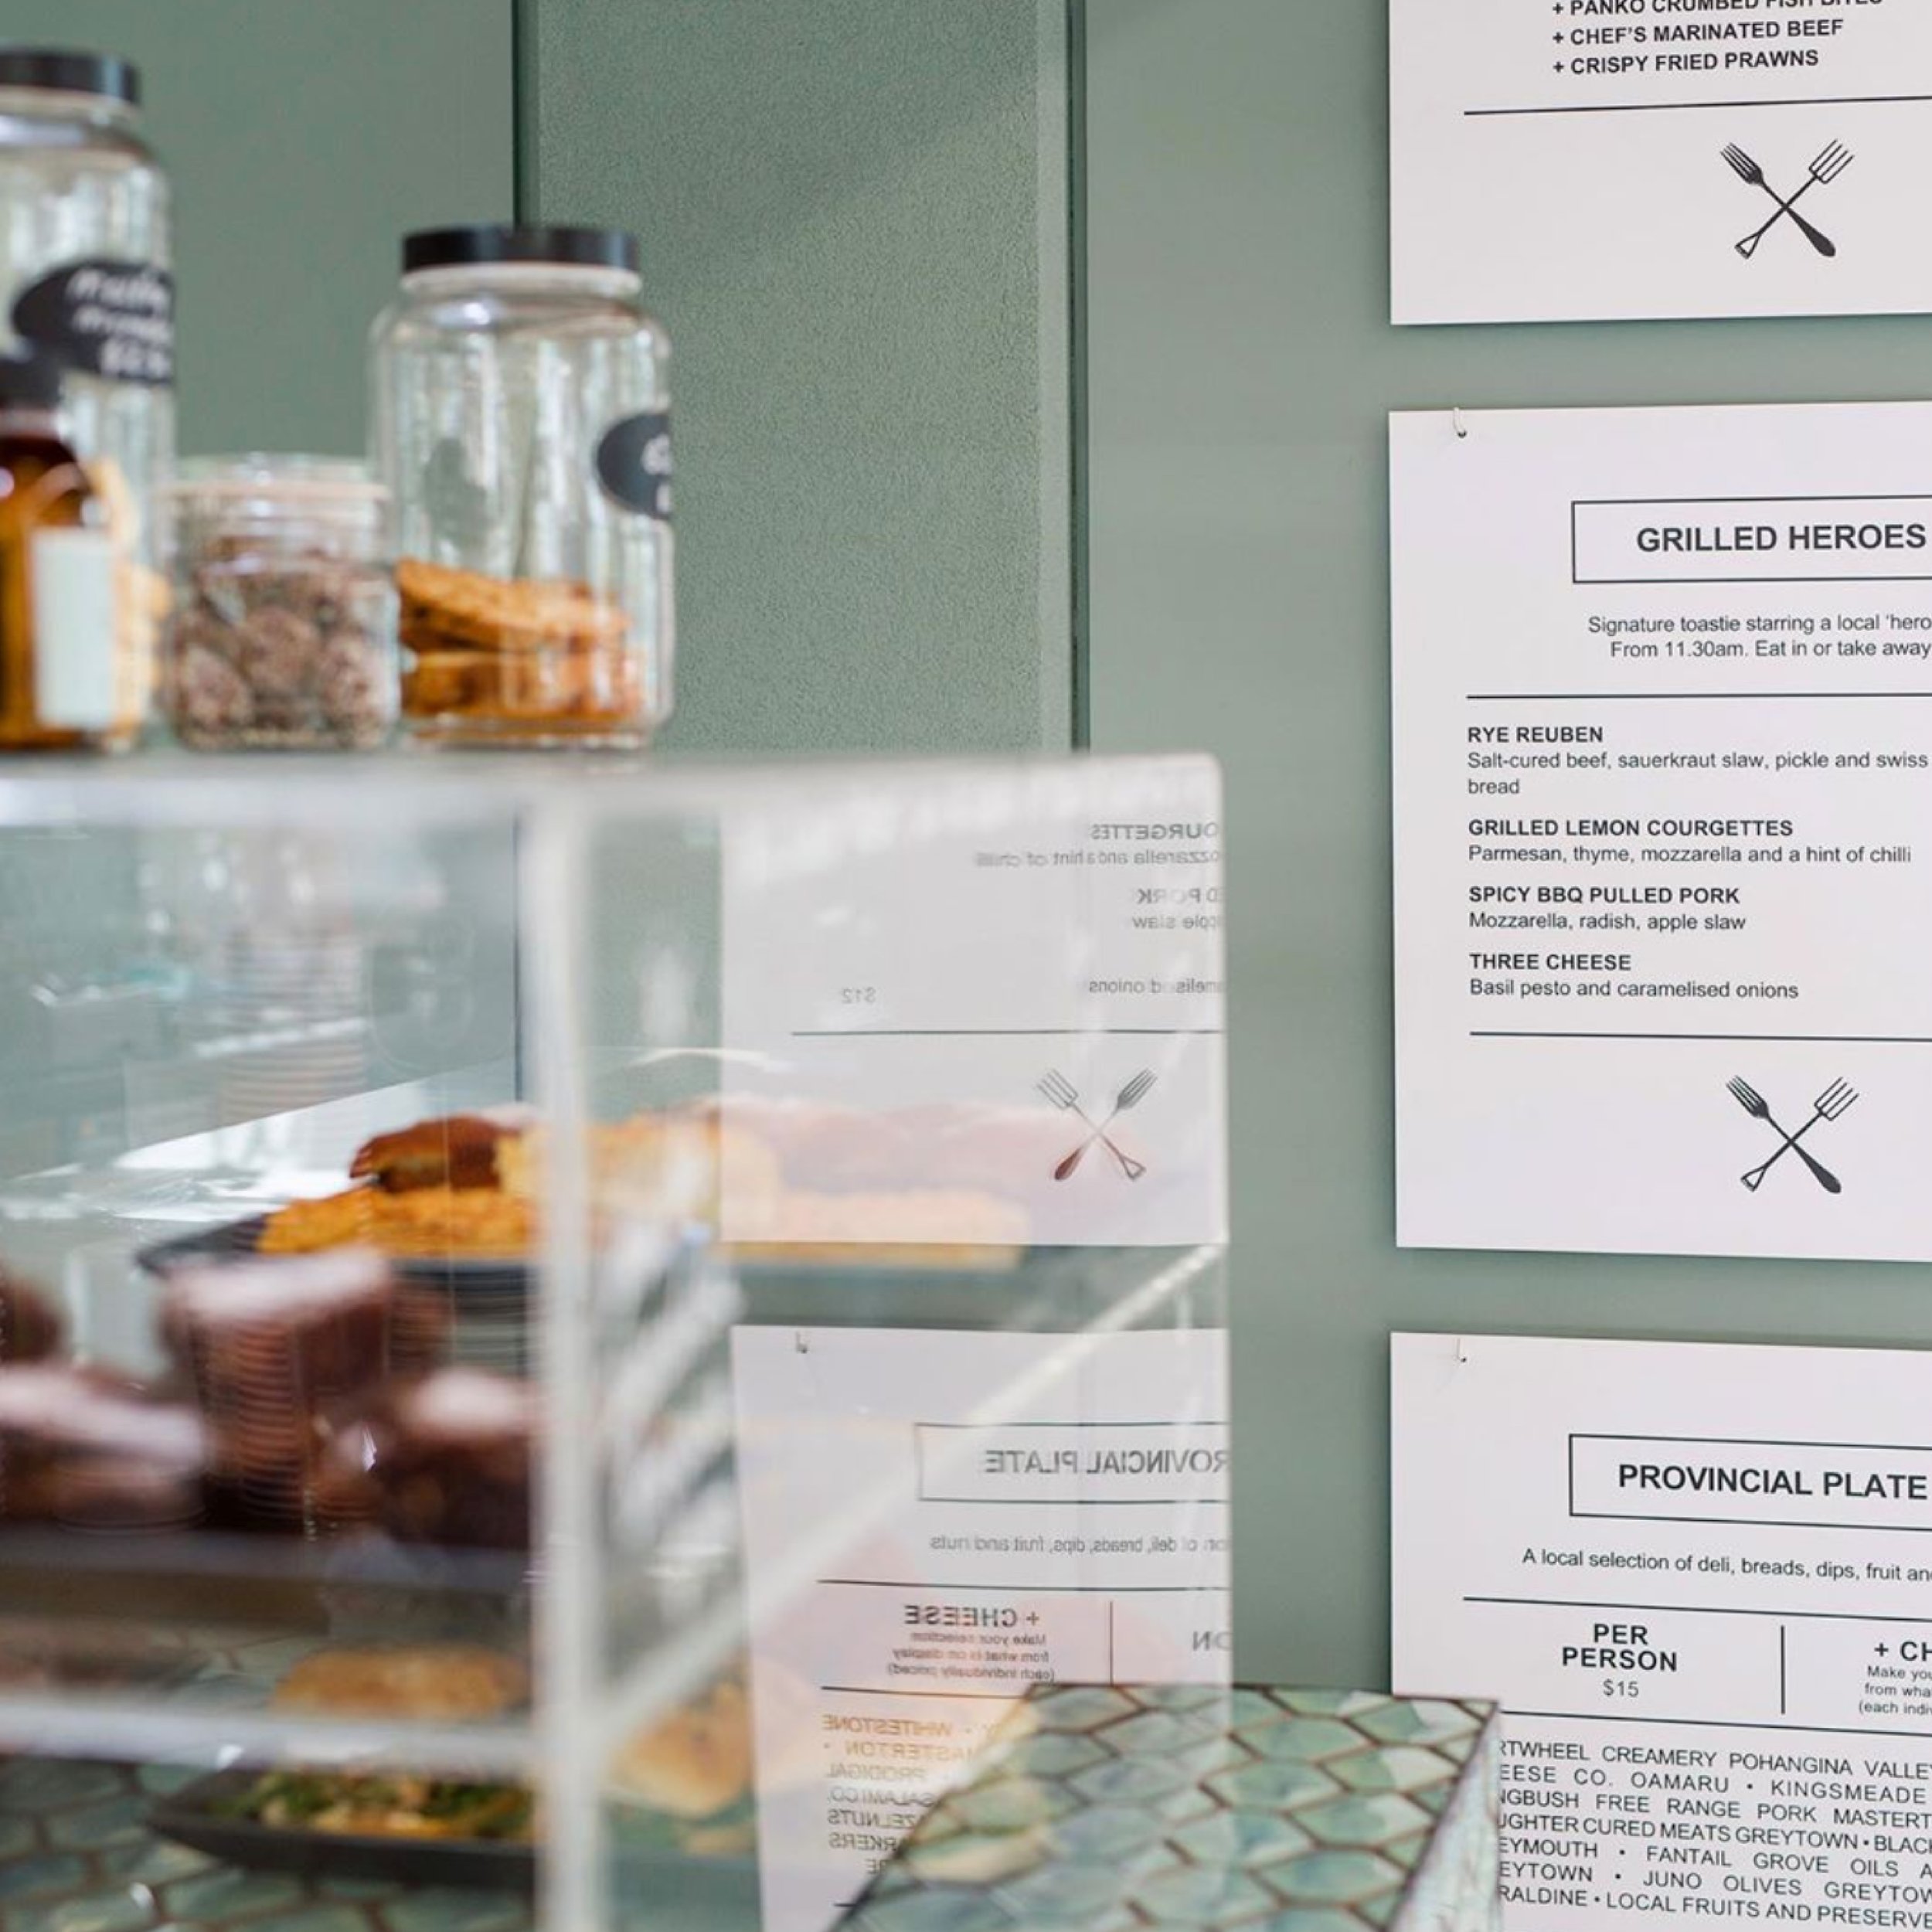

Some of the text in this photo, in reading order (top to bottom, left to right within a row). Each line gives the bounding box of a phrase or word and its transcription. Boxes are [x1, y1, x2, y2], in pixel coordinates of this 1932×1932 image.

[1570, 0, 1646, 17] PANKO
[1650, 0, 1760, 14] CRUMBED
[1570, 24, 1648, 46] CHEF'S
[1652, 20, 1781, 43] MARINATED
[1786, 17, 1845, 38] BEEF
[1570, 54, 1650, 76] CRISPY
[1655, 52, 1719, 72] FRIED
[1724, 48, 1819, 70] PRAWNS
[1635, 522, 1927, 553] GRILLED HEROES
[1587, 615, 1675, 638] Signature
[1679, 614, 1742, 634] toastie
[1745, 614, 1815, 637] starring
[1818, 617, 1832, 632] a
[1837, 613, 1881, 637] local
[1610, 638, 1932, 661] From 11.30am. Eat in or take away
[1467, 725, 1604, 745] RYE REUBEN
[1467, 750, 1932, 773] Salt-cured beef, sauerkraut slaw, pickle and swiss
[1467, 777, 1521, 795] bread
[1468, 818, 1794, 838] GRILLED LEMON COURGETTES
[1468, 843, 1912, 866] Parmesan, thyme, mozzarella and a hint of chilli
[1468, 885, 1741, 905] SPICY BBQ PULLED PORK
[1468, 910, 1747, 934] Mozzarella, radish, apple slaw
[1468, 951, 1632, 972] THREE CHEESE
[1469, 977, 1800, 999] Basil pesto and caramelised onions
[1618, 1463, 1929, 1501] PROVINCIAL PLATE
[1521, 1547, 1932, 1583] A local selection of deli, breads, dips, fruit an
[1592, 1621, 1649, 1647] PER
[1561, 1645, 1678, 1673] PERSON
[1603, 1677, 1640, 1699] $15
[1601, 1746, 1717, 1767] CREAMERY
[1729, 1752, 1853, 1775] POHANGINA
[1864, 1760, 1932, 1780] VALLE
[1573, 1767, 1613, 1787] CO.
[1630, 1771, 1729, 1792] OAMARU
[1771, 1779, 1927, 1804] KINGSMEADE
[1596, 1794, 1651, 1813] FREE
[1666, 1798, 1741, 1818] RANGE
[1757, 1803, 1817, 1825] PORK
[1583, 1818, 1656, 1837] CURED
[1660, 1821, 1731, 1842] MEATS
[1735, 1826, 1859, 1849] GREYTOWN
[1874, 1835, 1932, 1854] BLAC
[1647, 1845, 1733, 1867] FANTAIL
[1753, 1852, 1829, 1872] GROVE
[1850, 1857, 1900, 1877] OILS
[1643, 1870, 1702, 1889] JUNO
[1723, 1874, 1802, 1896] OLIVES
[1607, 1892, 1677, 1912] LOCAL
[1683, 1896, 1760, 1917] FRUITS
[1765, 1902, 1811, 1920] AND
